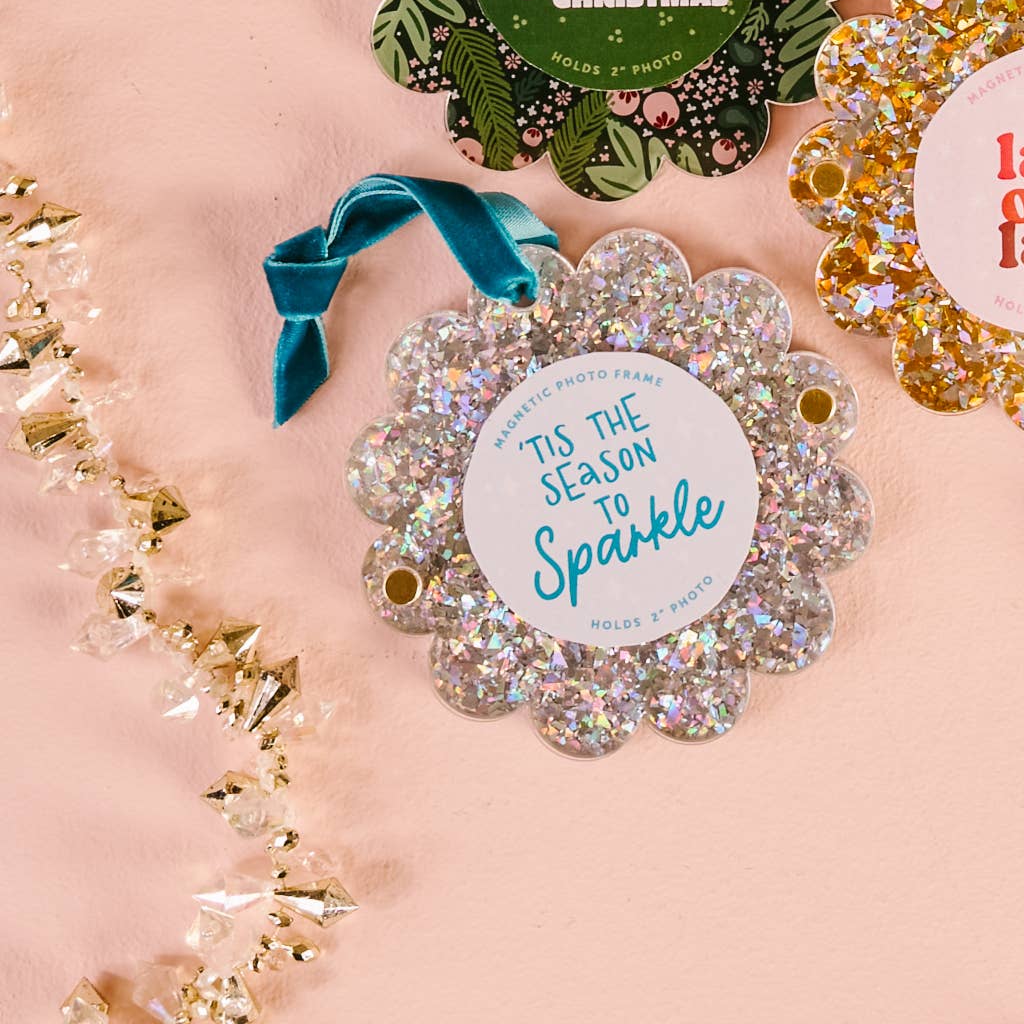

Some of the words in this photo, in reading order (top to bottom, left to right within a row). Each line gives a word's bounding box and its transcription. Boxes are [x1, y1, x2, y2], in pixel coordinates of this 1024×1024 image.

[551, 51, 601, 75] HOLDS
[633, 51, 682, 75] PHOTO
[494, 388, 552, 449] MAGNETIC
[556, 370, 607, 391] PHOTO
[614, 370, 664, 388] FRAME
[586, 392, 650, 440] THE
[593, 493, 630, 525] TO
[534, 478, 725, 607] Sparkle
[591, 618, 641, 630] HOLDS
[670, 576, 713, 613] PHOTO
